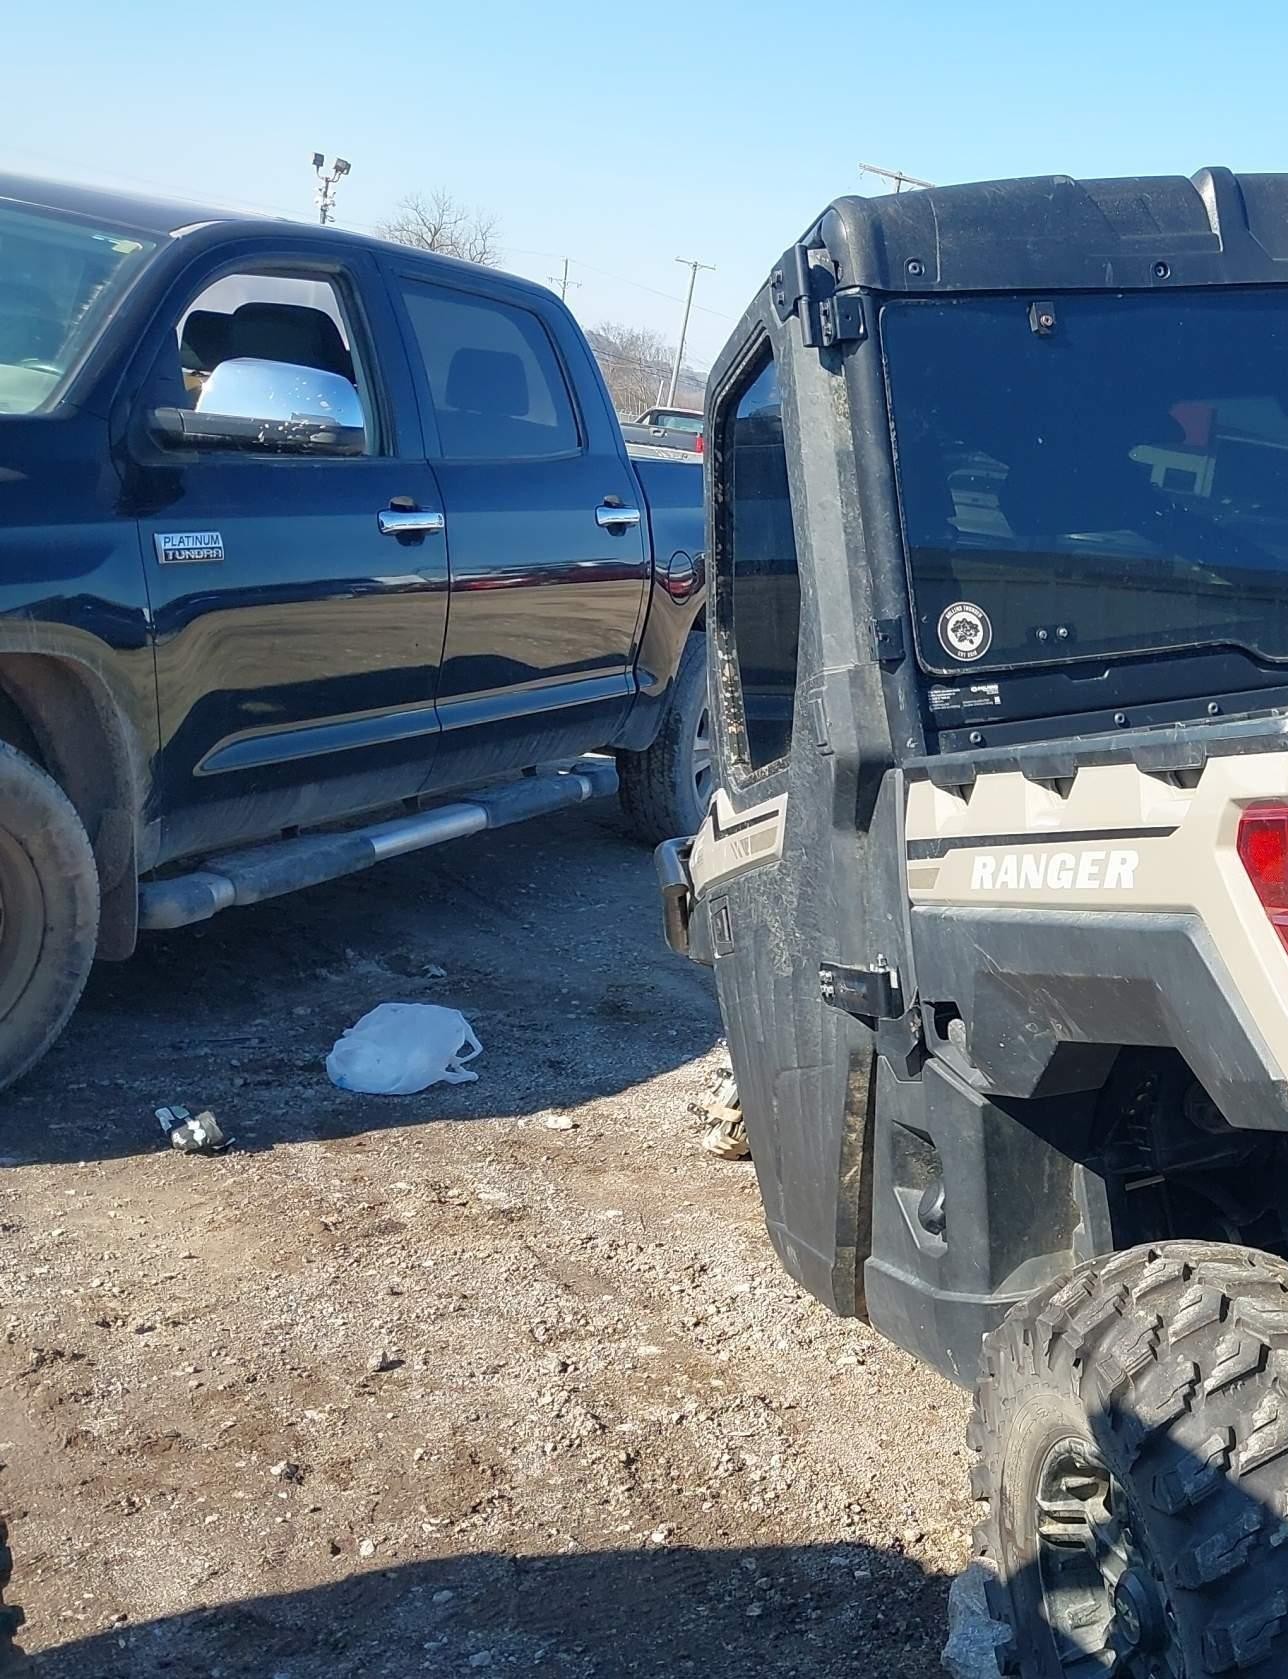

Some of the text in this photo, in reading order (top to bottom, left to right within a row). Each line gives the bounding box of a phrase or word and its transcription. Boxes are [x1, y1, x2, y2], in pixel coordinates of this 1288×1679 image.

[163, 534, 220, 548] PLATINUM
[164, 548, 222, 560] TUNDRA
[970, 850, 1139, 890] RANGER
